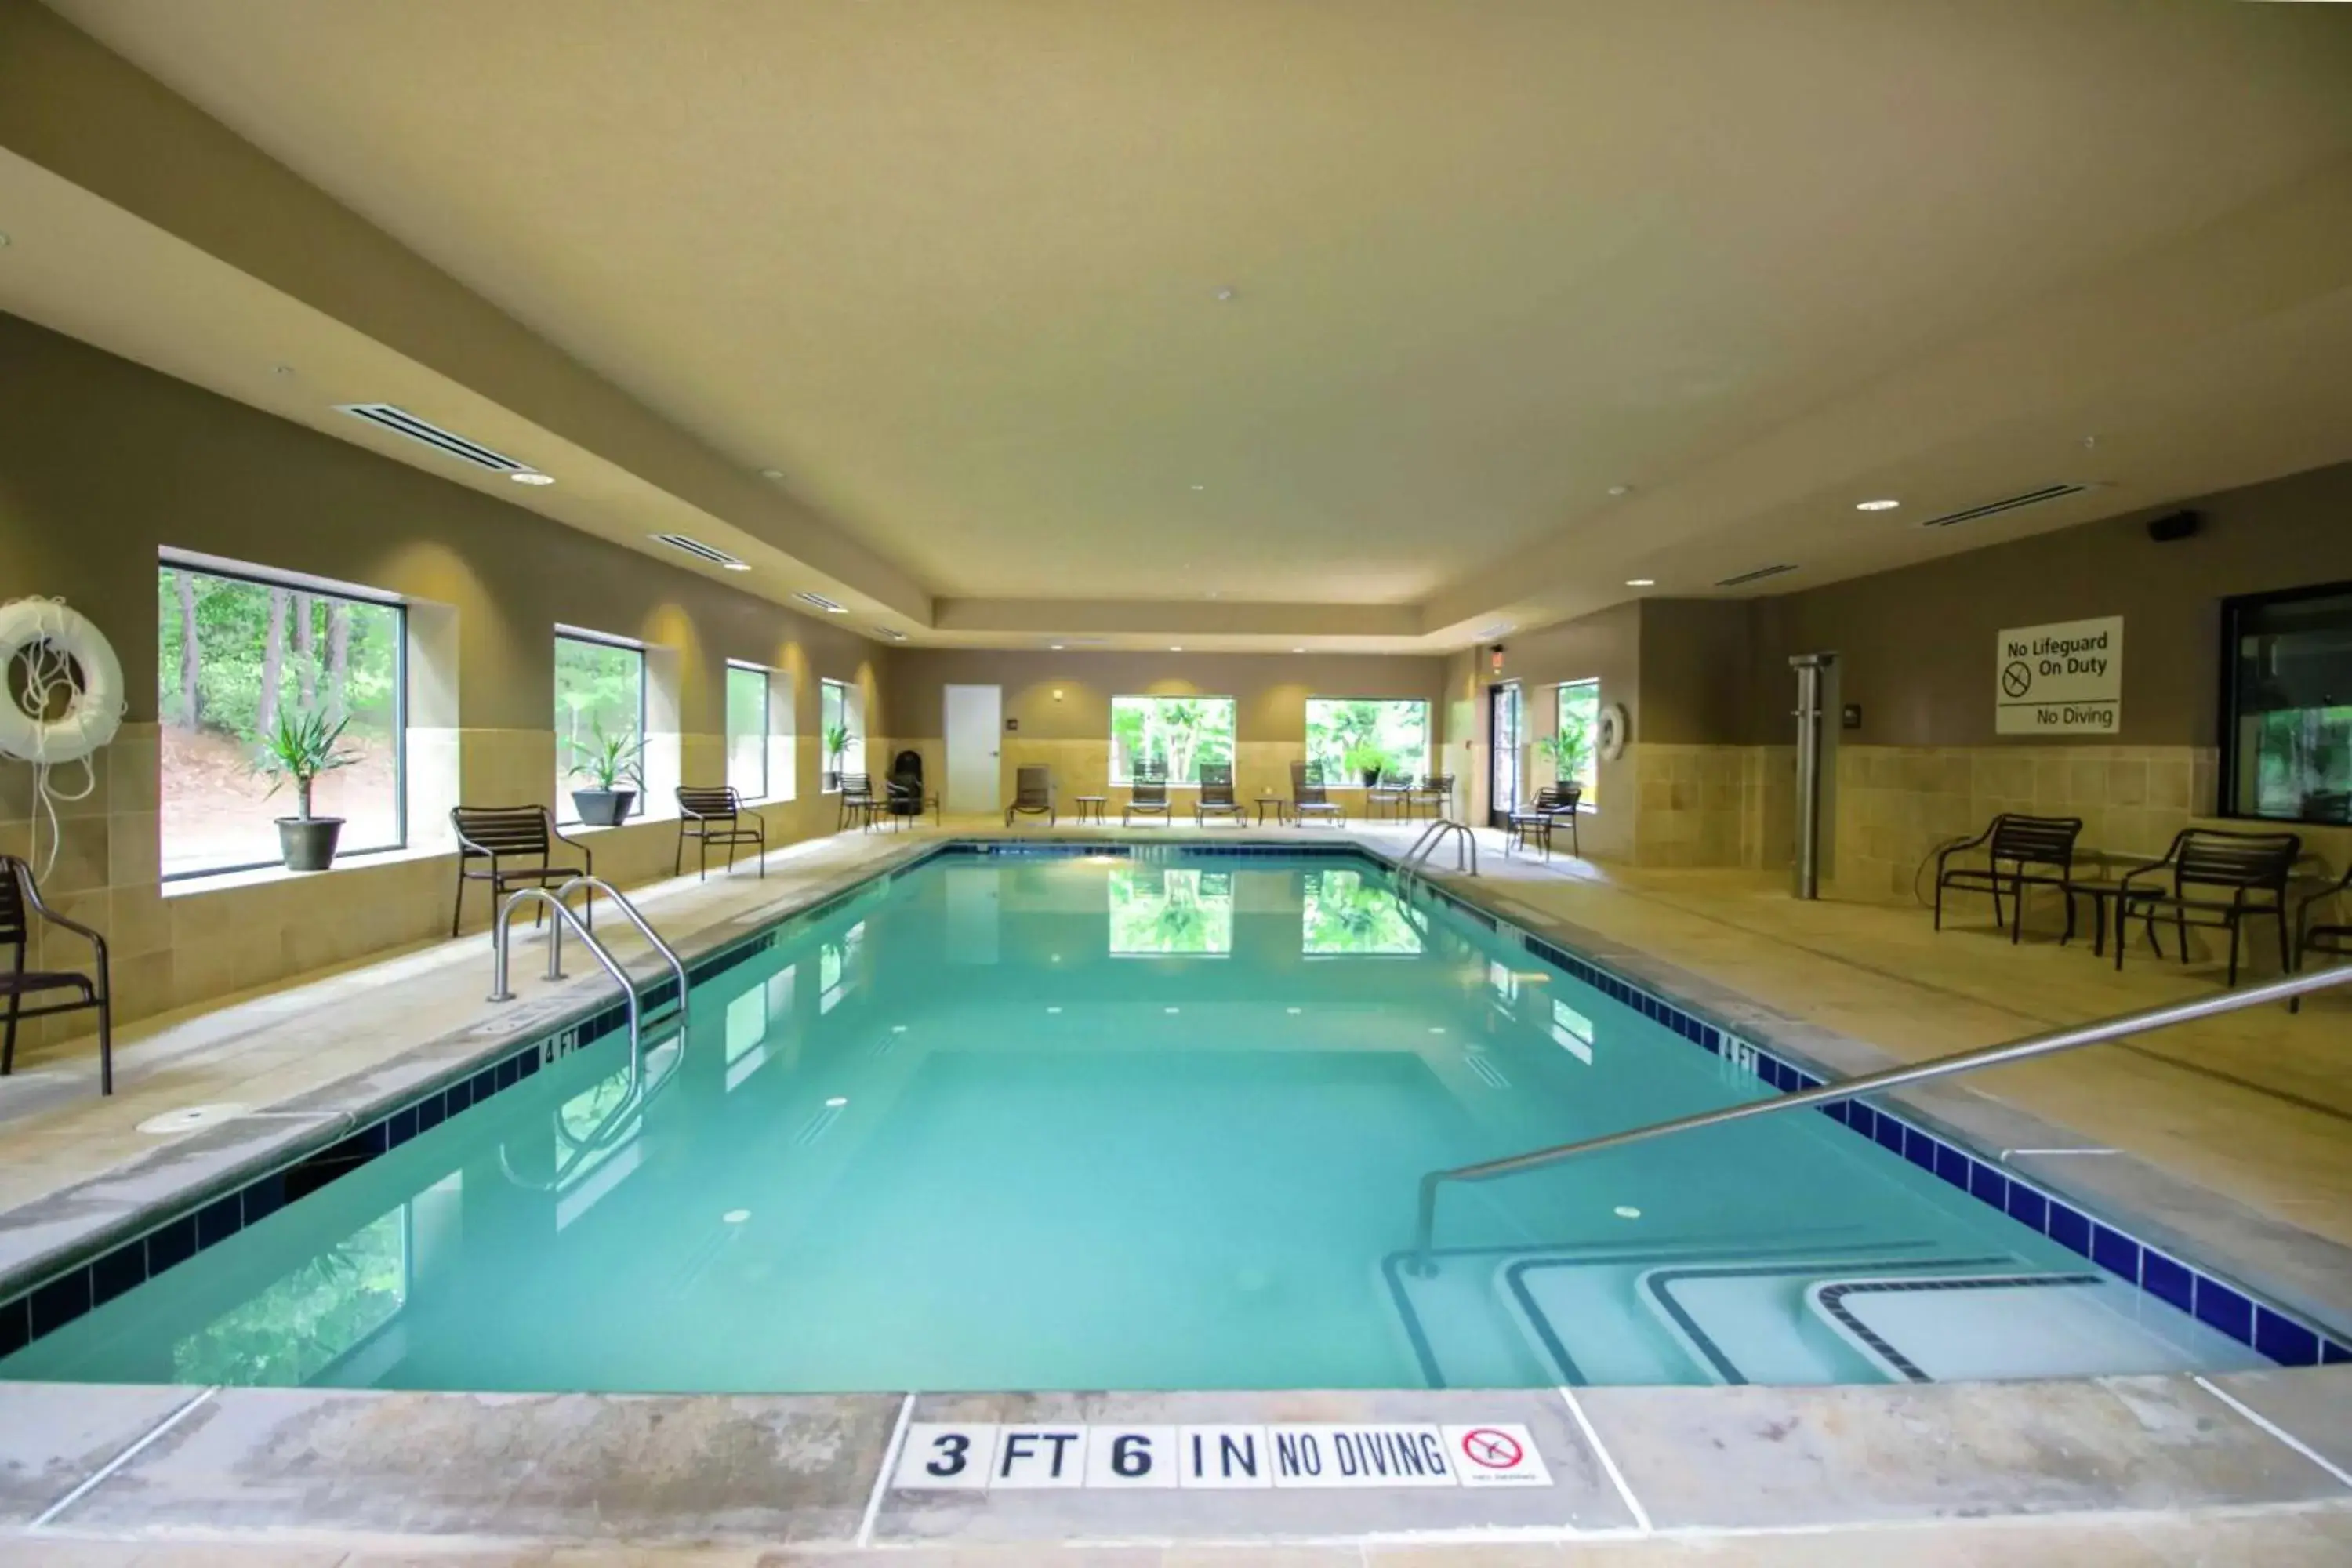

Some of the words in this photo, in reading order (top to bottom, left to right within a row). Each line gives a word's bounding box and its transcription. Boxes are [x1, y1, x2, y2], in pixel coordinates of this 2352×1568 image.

[2008, 641, 2027, 658] No
[2033, 630, 2107, 657] Lifeguard
[2039, 660, 2061, 676] On
[2067, 657, 2107, 677] Duty
[2038, 709, 2058, 724] No
[2063, 707, 2113, 728] Diving
[545, 1039, 554, 1064] 4
[560, 1028, 577, 1060] FT
[926, 1432, 971, 1478] 3
[1000, 1433, 1080, 1479] FT
[1111, 1434, 1153, 1478] 6
[1192, 1433, 1258, 1478] IN
[1276, 1432, 1323, 1477] NO
[1333, 1432, 1448, 1477] DIVING
